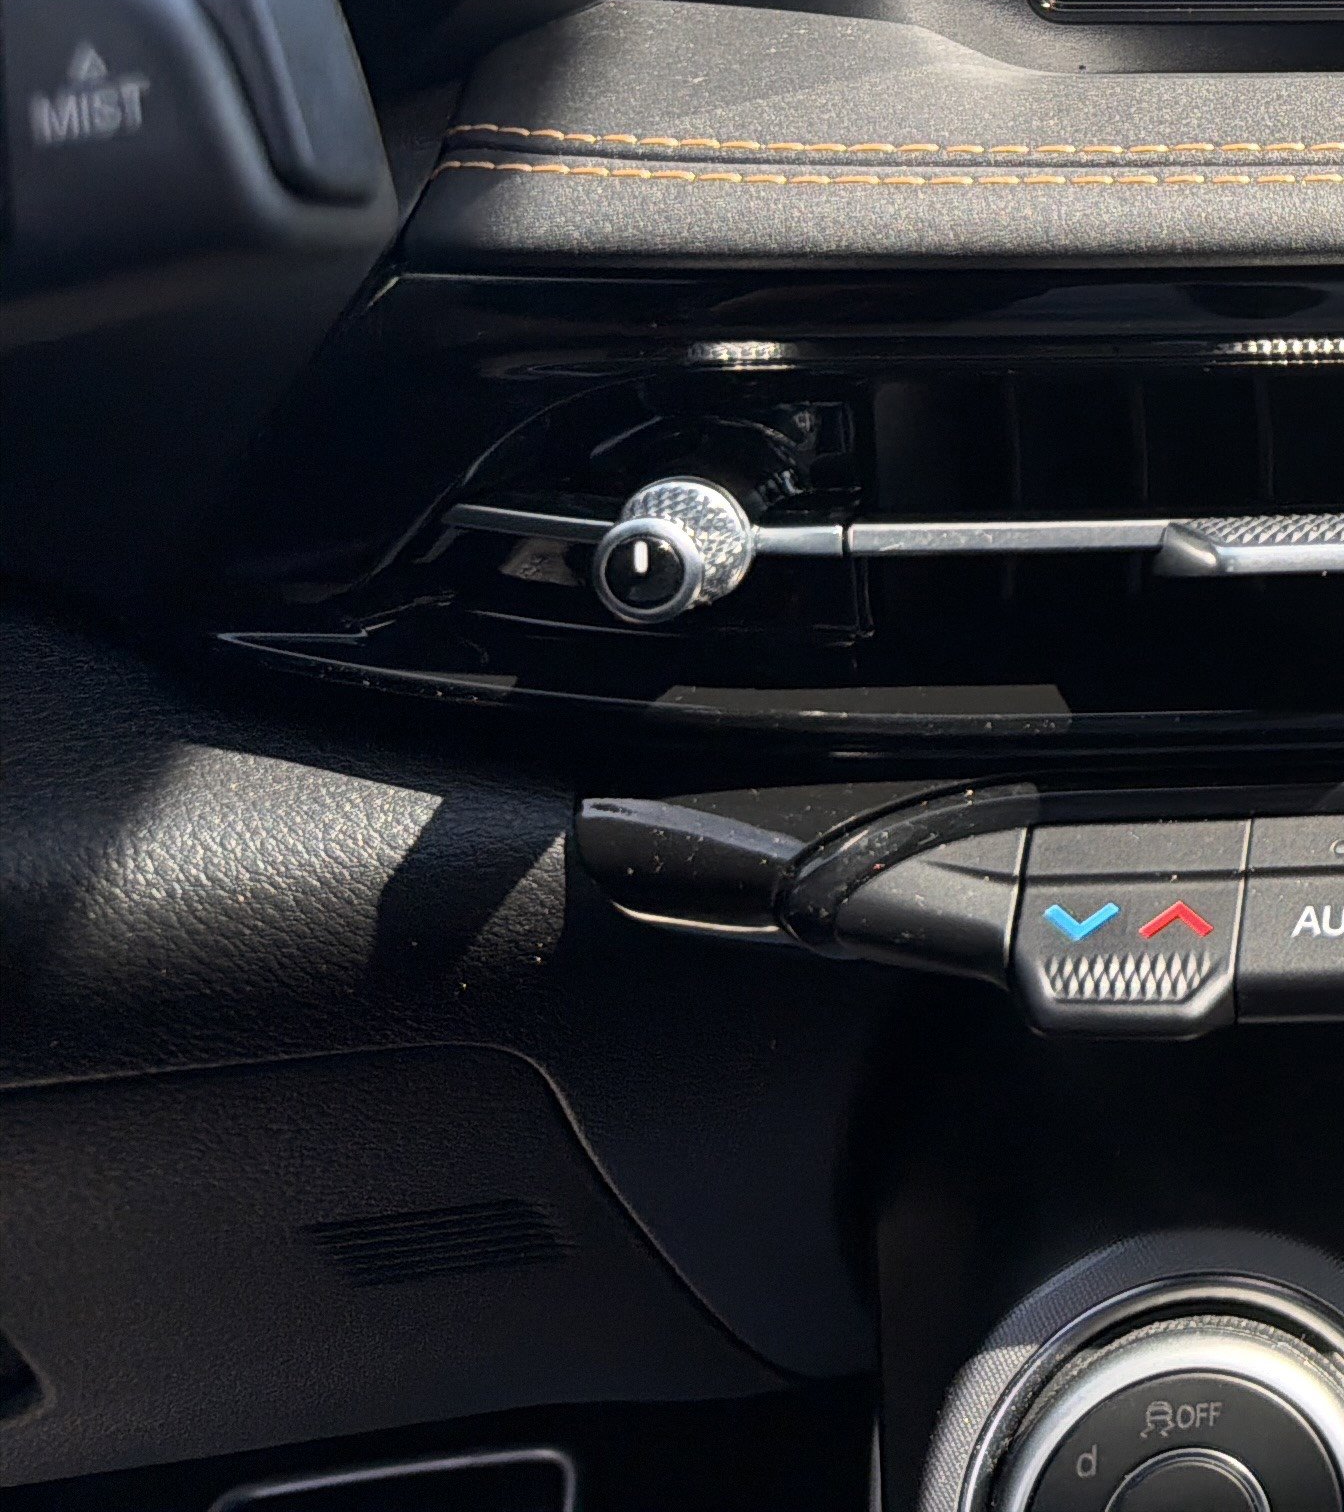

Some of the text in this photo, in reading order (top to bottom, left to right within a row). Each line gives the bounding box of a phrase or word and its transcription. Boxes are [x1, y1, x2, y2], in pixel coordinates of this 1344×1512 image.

[28, 73, 150, 146] MIST
[1175, 1401, 1223, 1429] OFF
[1076, 1444, 1098, 1479] d
